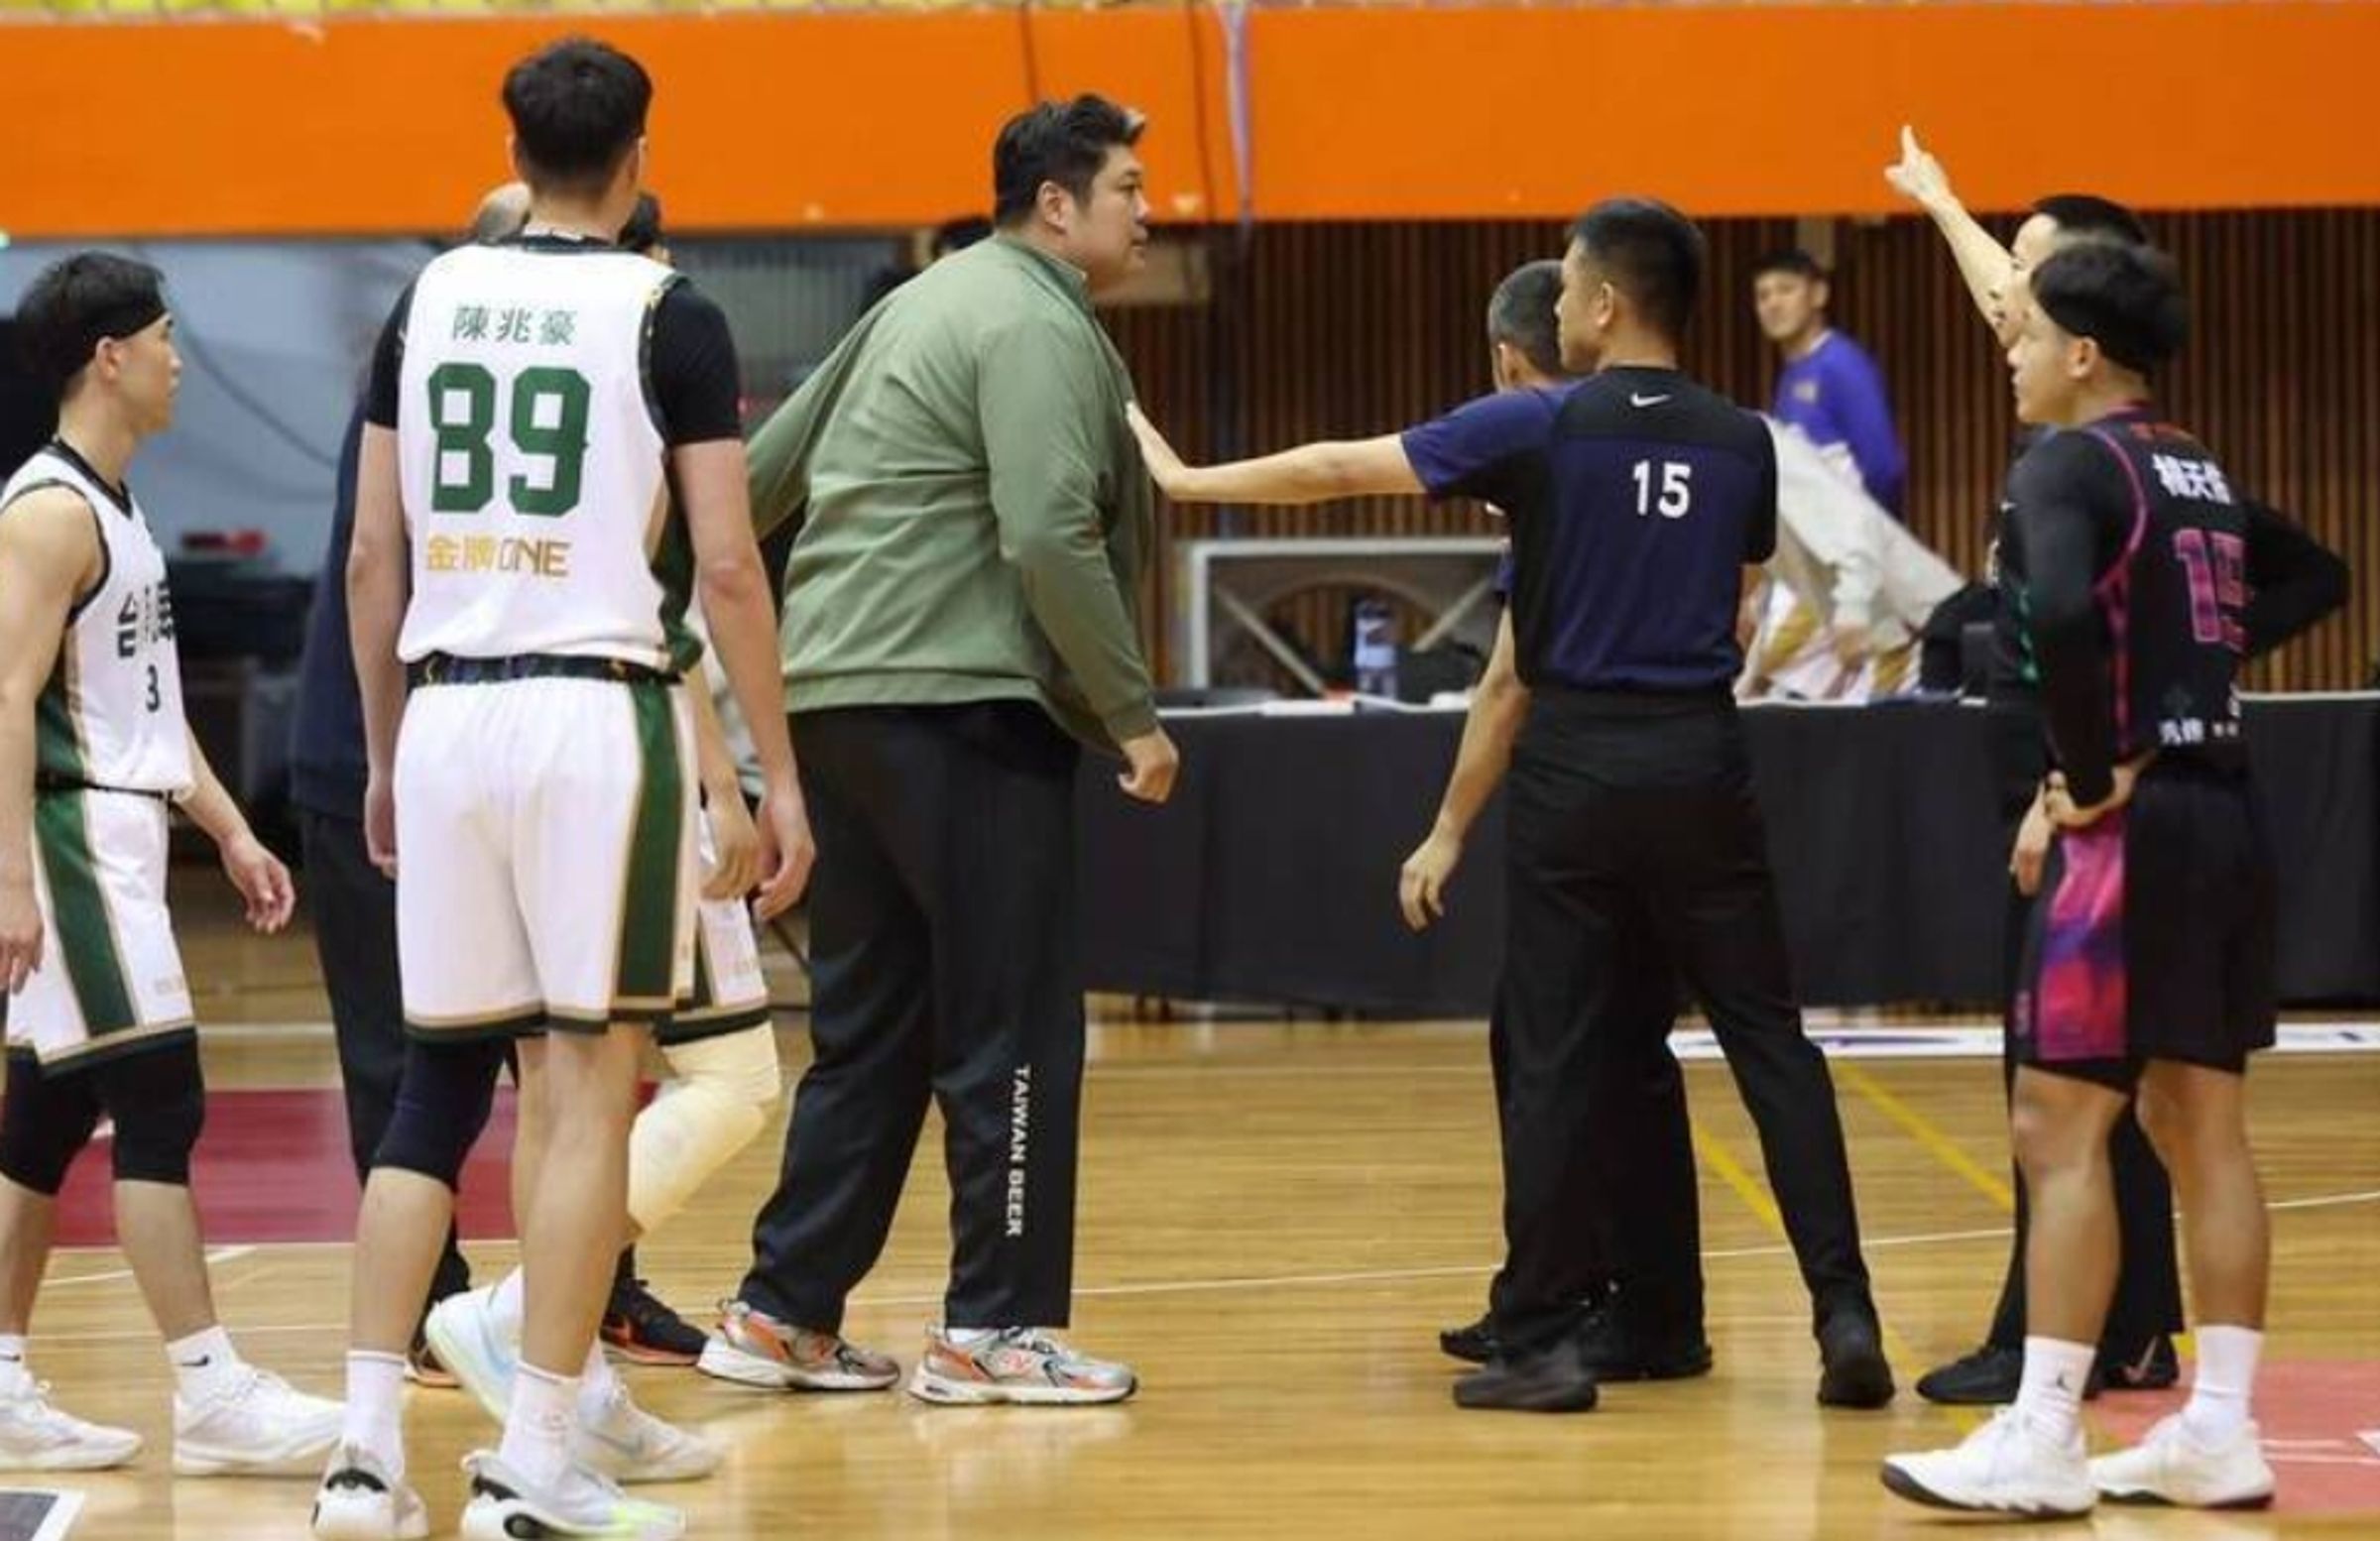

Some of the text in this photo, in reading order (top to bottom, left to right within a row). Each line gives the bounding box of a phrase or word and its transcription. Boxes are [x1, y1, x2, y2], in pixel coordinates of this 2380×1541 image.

[452, 305, 577, 344] 陳兆豪
[428, 363, 591, 517] 89
[1633, 459, 1691, 519] 15
[145, 663, 162, 713] 3
[1006, 1062, 1031, 1237] TAIWAN BEER
